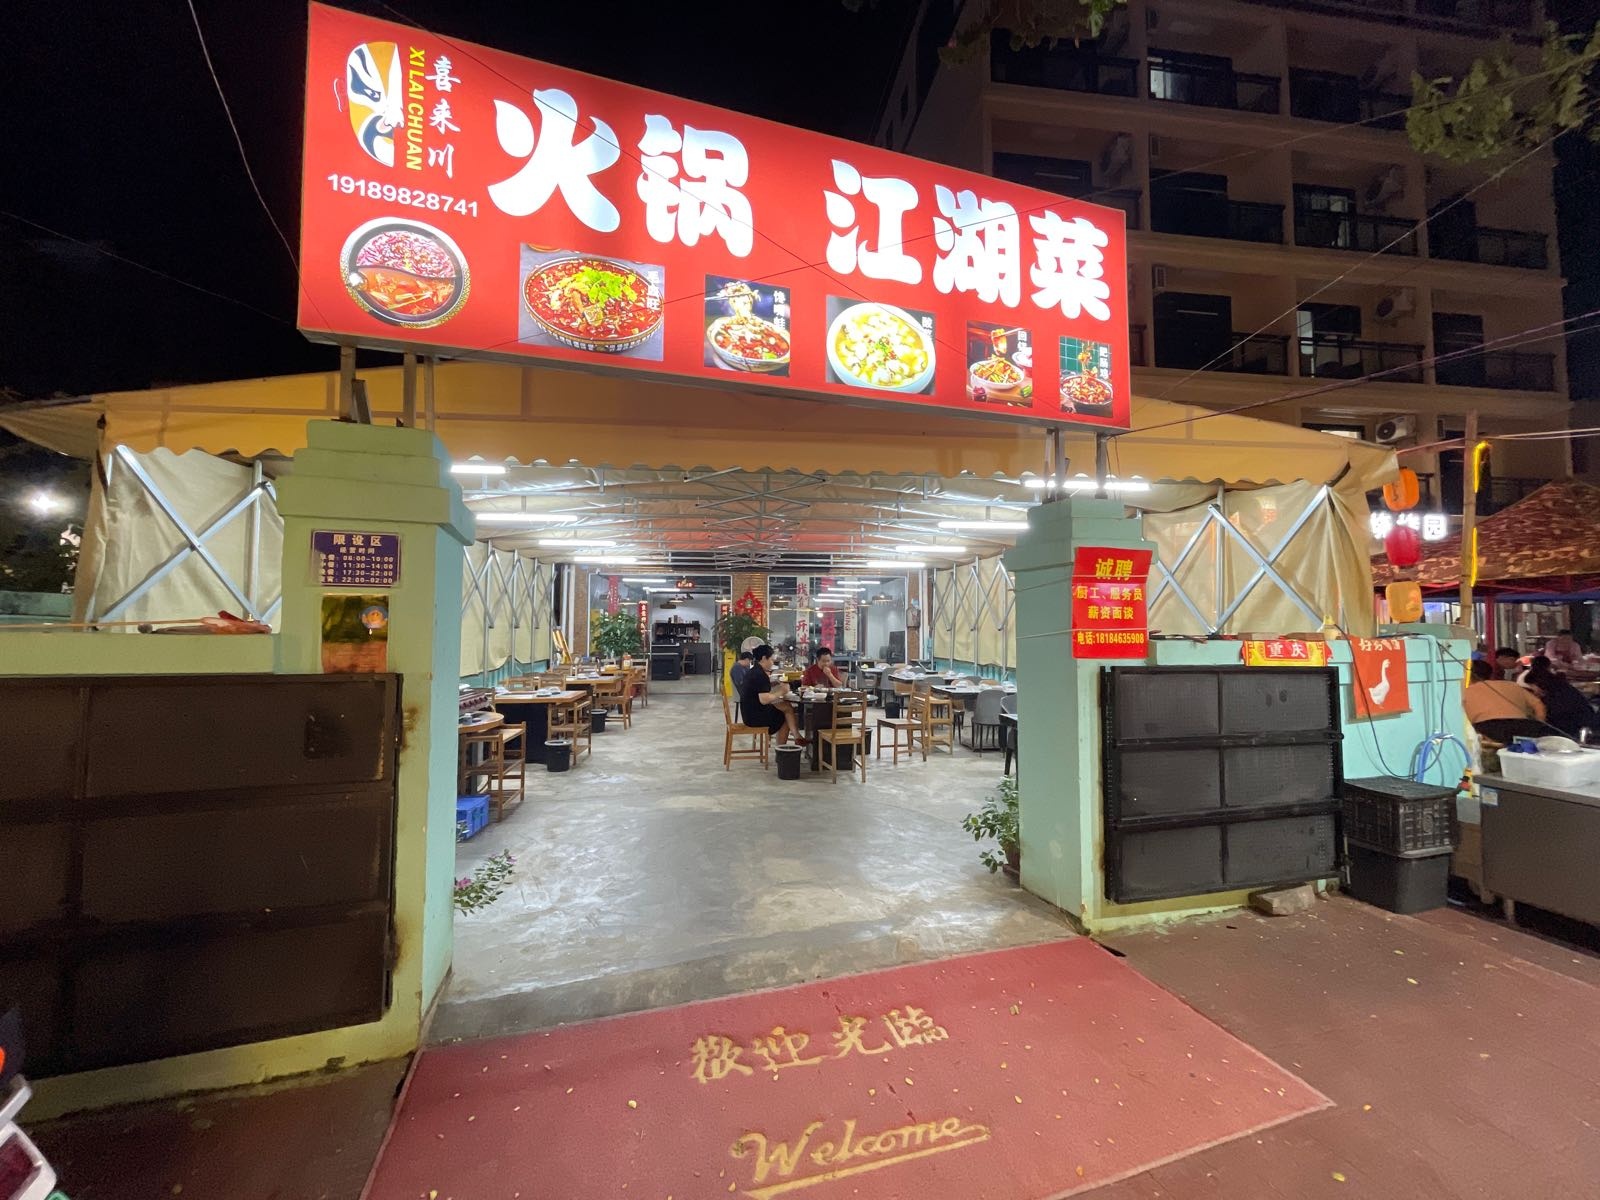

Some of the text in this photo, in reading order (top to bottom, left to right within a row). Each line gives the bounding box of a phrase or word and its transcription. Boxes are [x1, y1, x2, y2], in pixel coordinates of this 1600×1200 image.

[406, 46, 425, 171] XI LAI CHUAN
[425, 55, 461, 178] 喜来川
[327, 173, 478, 218] 19189828741
[487, 88, 1110, 321] 火锅 江湖菜
[1096, 558, 1133, 581] 诚聘
[1088, 606, 1134, 619] 薪资面谈
[1267, 642, 1306, 658] 重庆
[729, 1117, 990, 1183] Welcome
